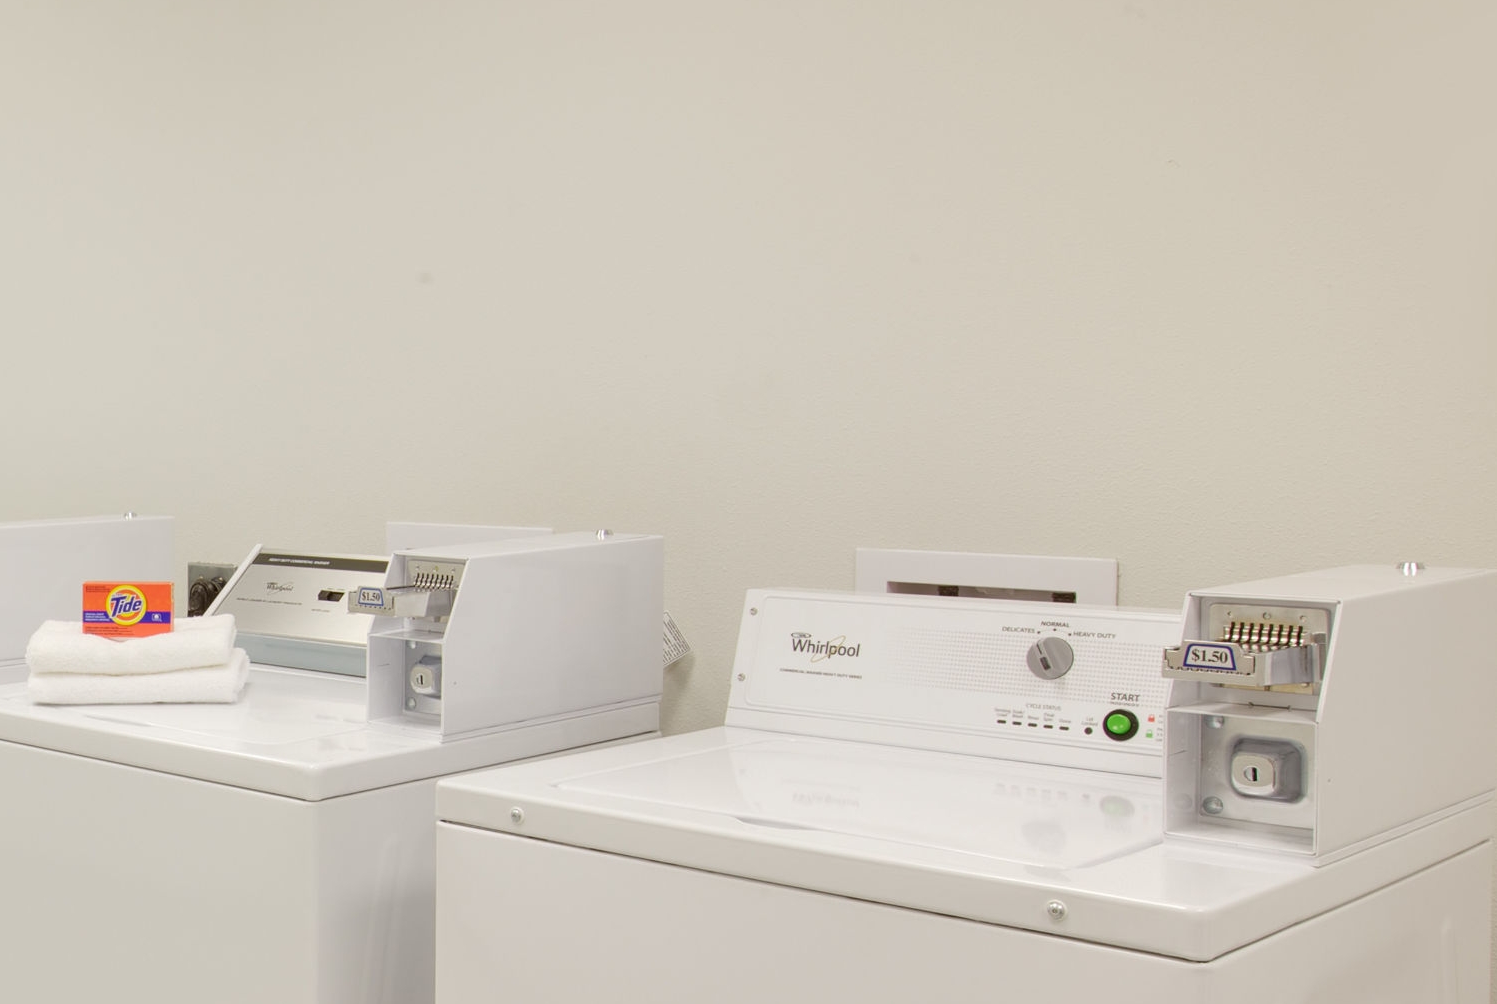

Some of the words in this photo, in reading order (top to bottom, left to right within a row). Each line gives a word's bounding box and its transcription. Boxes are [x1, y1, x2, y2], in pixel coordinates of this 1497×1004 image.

[361, 591, 381, 602] $1.50
[110, 595, 143, 618] Tide
[1040, 620, 1070, 628] NORMAL
[1001, 625, 1036, 634] DELICATES
[1073, 630, 1097, 639] HEAVY
[1096, 632, 1117, 640] DUTY
[792, 637, 861, 659] Whirlpool
[1191, 648, 1229, 664] $1.50
[1110, 692, 1141, 702] START
